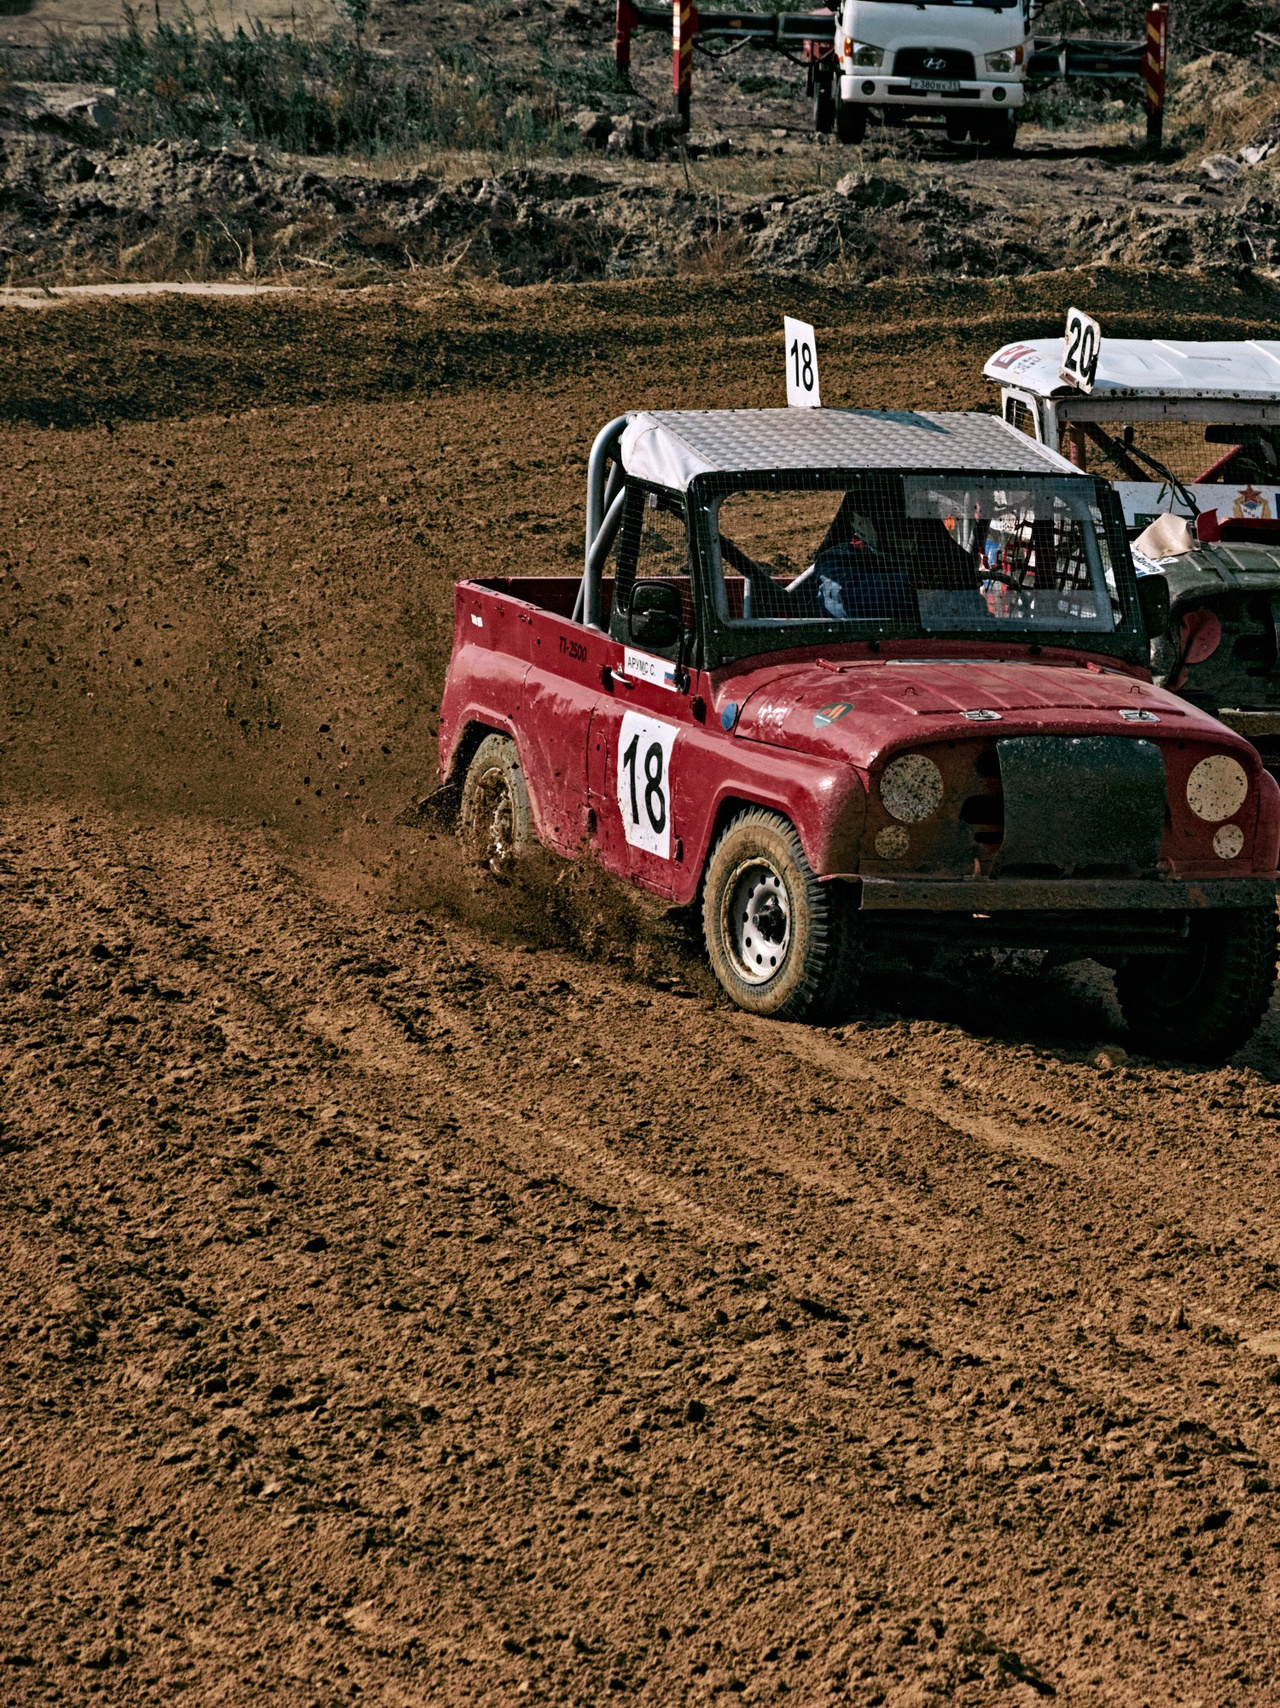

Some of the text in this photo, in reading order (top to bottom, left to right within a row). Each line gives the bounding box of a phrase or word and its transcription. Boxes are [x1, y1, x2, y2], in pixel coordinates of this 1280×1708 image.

[790, 338, 814, 392] 18
[1065, 317, 1094, 378] 20
[624, 734, 666, 834] 18
